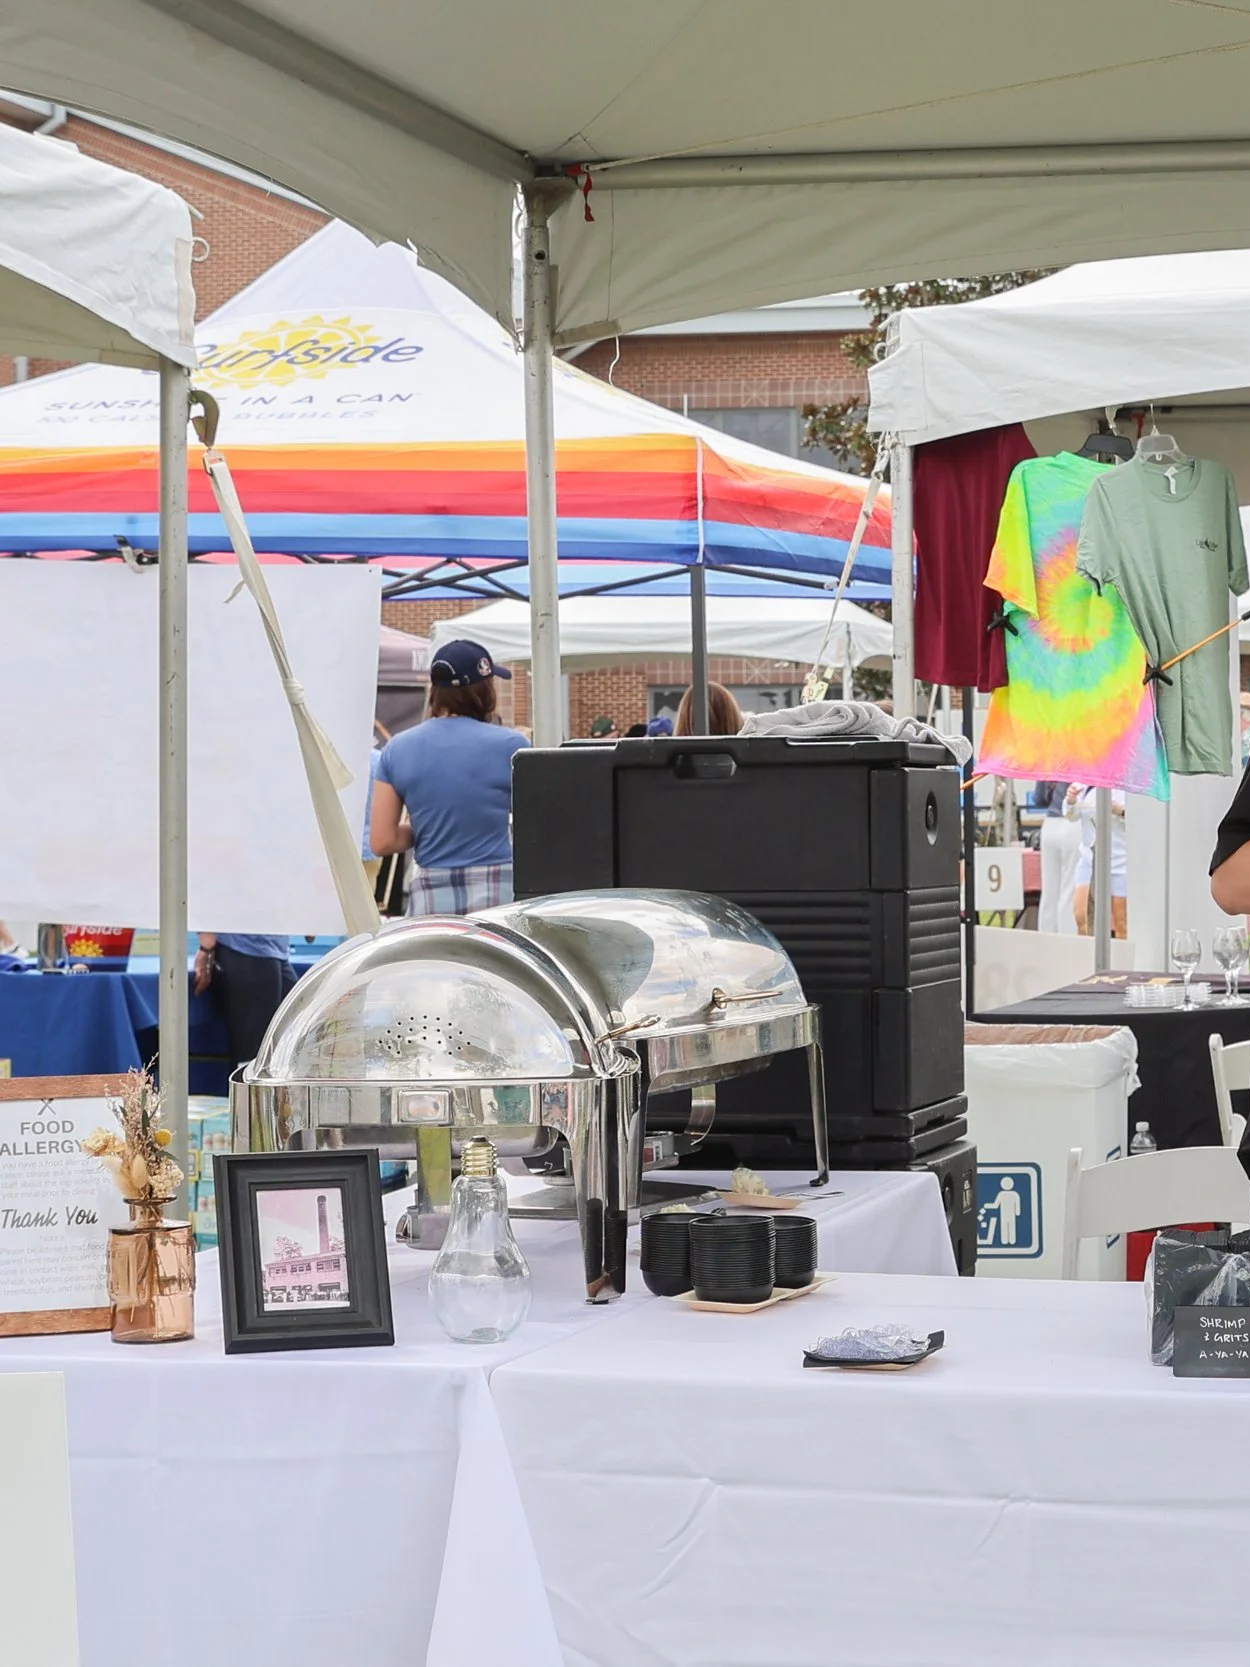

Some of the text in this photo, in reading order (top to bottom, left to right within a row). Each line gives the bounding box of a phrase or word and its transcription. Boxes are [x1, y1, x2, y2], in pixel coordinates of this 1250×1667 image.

[240, 396, 277, 406] IN
[290, 394, 314, 405] A
[337, 393, 415, 405] CAN
[988, 864, 1002, 893] 9
[20, 1120, 75, 1135] FOOD
[0, 1140, 83, 1156] ALLERGY
[1, 1205, 99, 1229] Thank You
[1199, 1316, 1246, 1329] SHRIMP
[1213, 1332, 1250, 1343] GRITS
